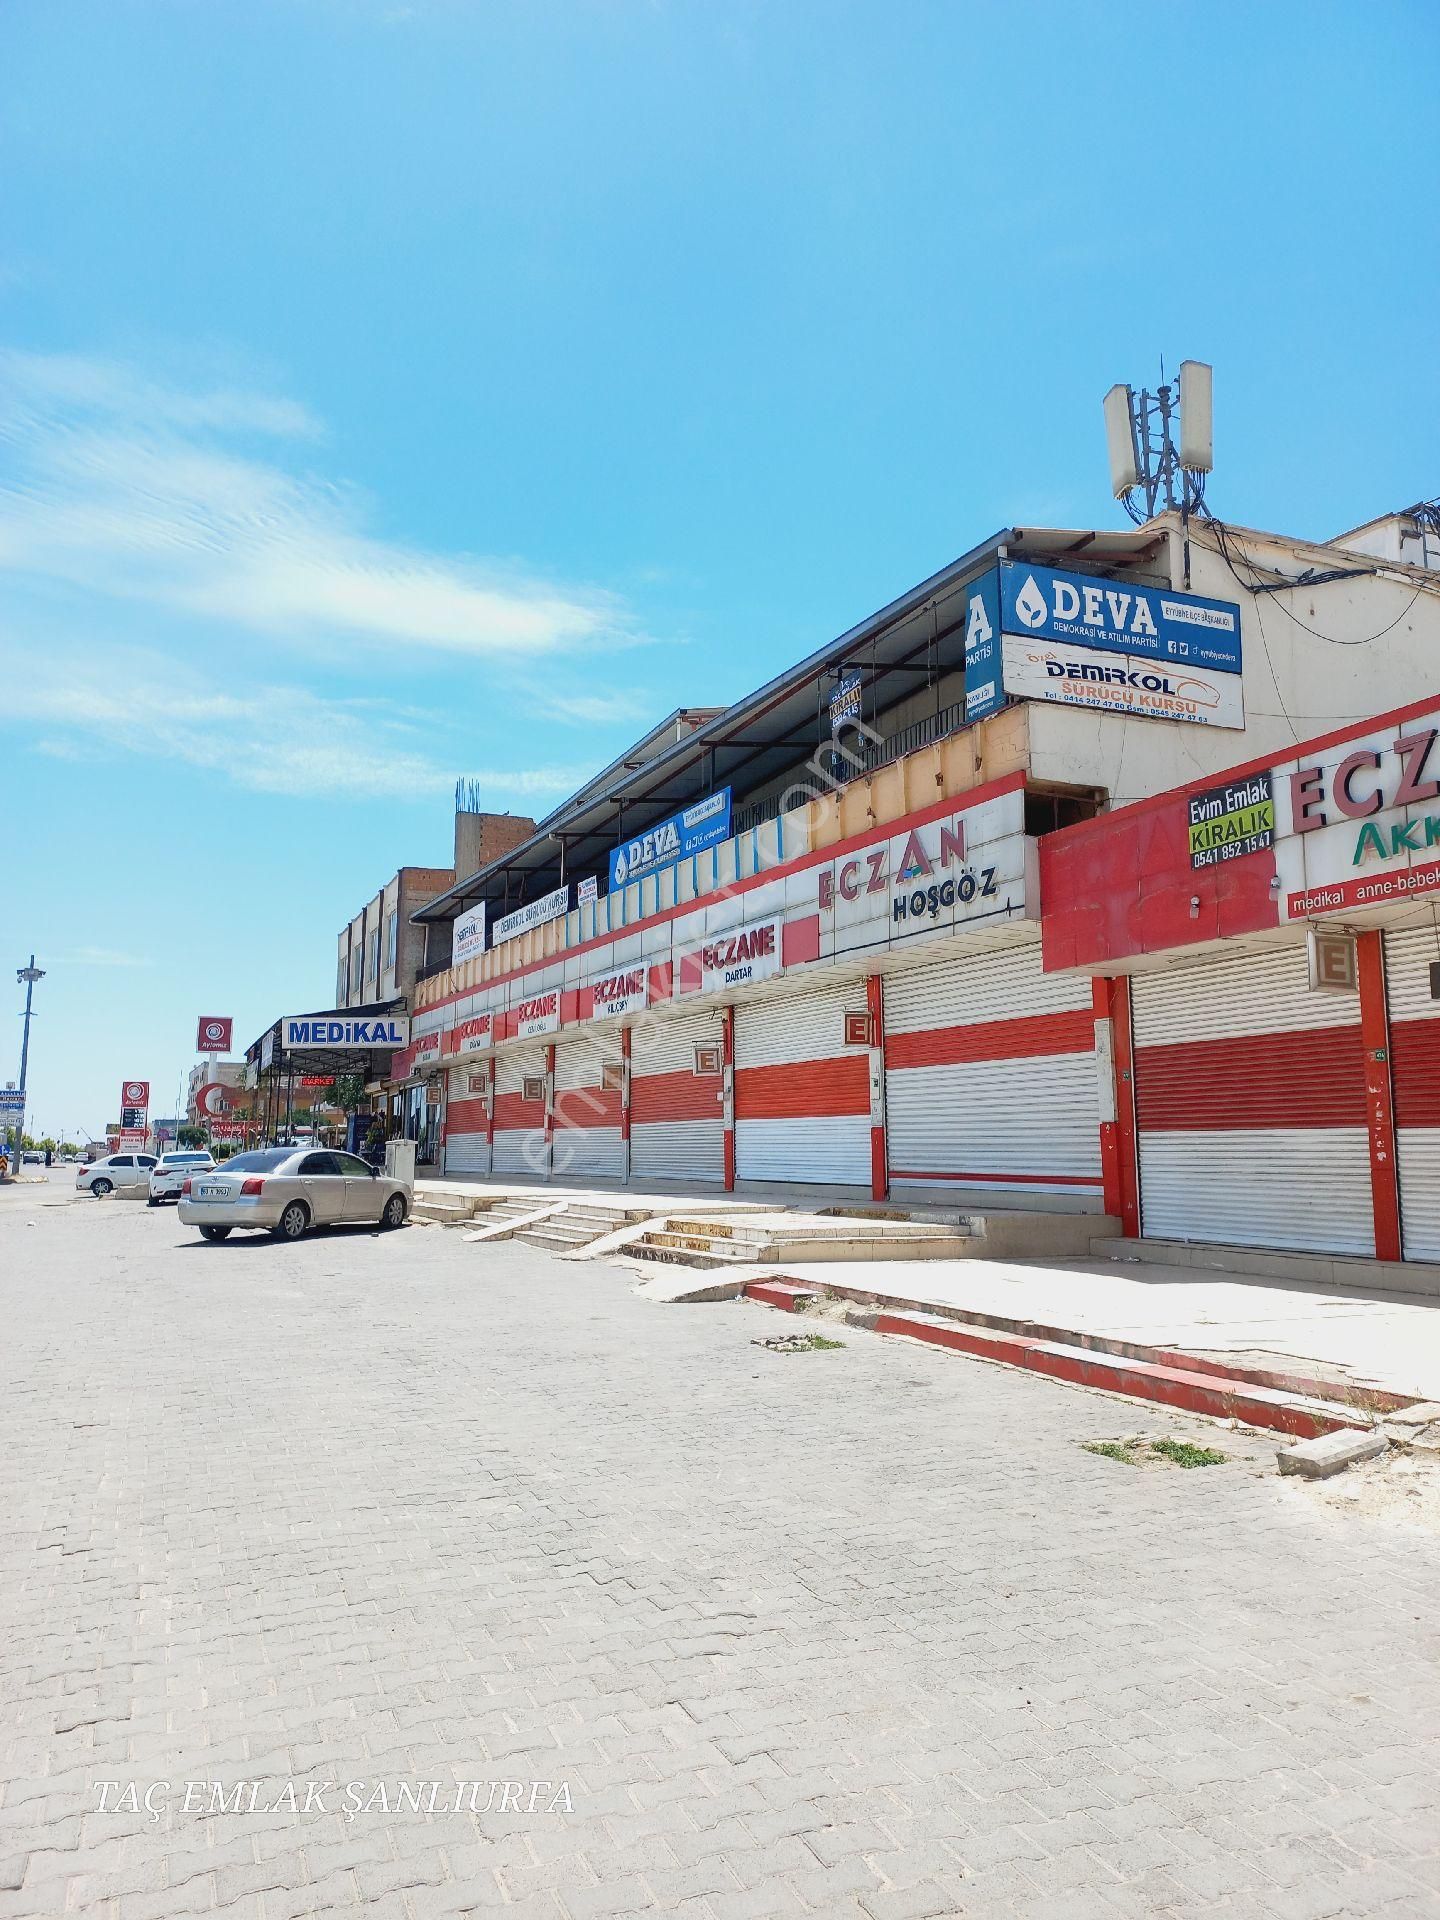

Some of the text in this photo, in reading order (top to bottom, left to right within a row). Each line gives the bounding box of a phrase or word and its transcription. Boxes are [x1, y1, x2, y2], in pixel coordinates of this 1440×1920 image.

[1052, 580, 1157, 635] DEVA
[1053, 622, 1158, 648] DEMOKRASİ VE ATILIM PARTİSİ
[1044, 691, 1056, 699] Tel
[1086, 698, 1101, 706] 247
[1115, 702, 1125, 710] 00
[1171, 711, 1185, 719] 247
[1187, 714, 1197, 722] 47
[1062, 681, 1198, 714] SÜRÜCÜ KURSU
[1190, 778, 1269, 824] Evim Emlak
[628, 822, 681, 869] DEVA
[1192, 806, 1271, 851] KİRALIK
[818, 819, 966, 910] ECZAN
[1194, 830, 1270, 868] 0541 852 15 41
[893, 866, 997, 922] HOŞGÖZ
[1293, 888, 1344, 911] medikal
[702, 924, 775, 972] ECZANE
[592, 968, 645, 1006] ECZANE
[725, 966, 752, 984] DARTAR
[517, 992, 557, 1023] ECZANE
[303, 1078, 335, 1086] MARKET
